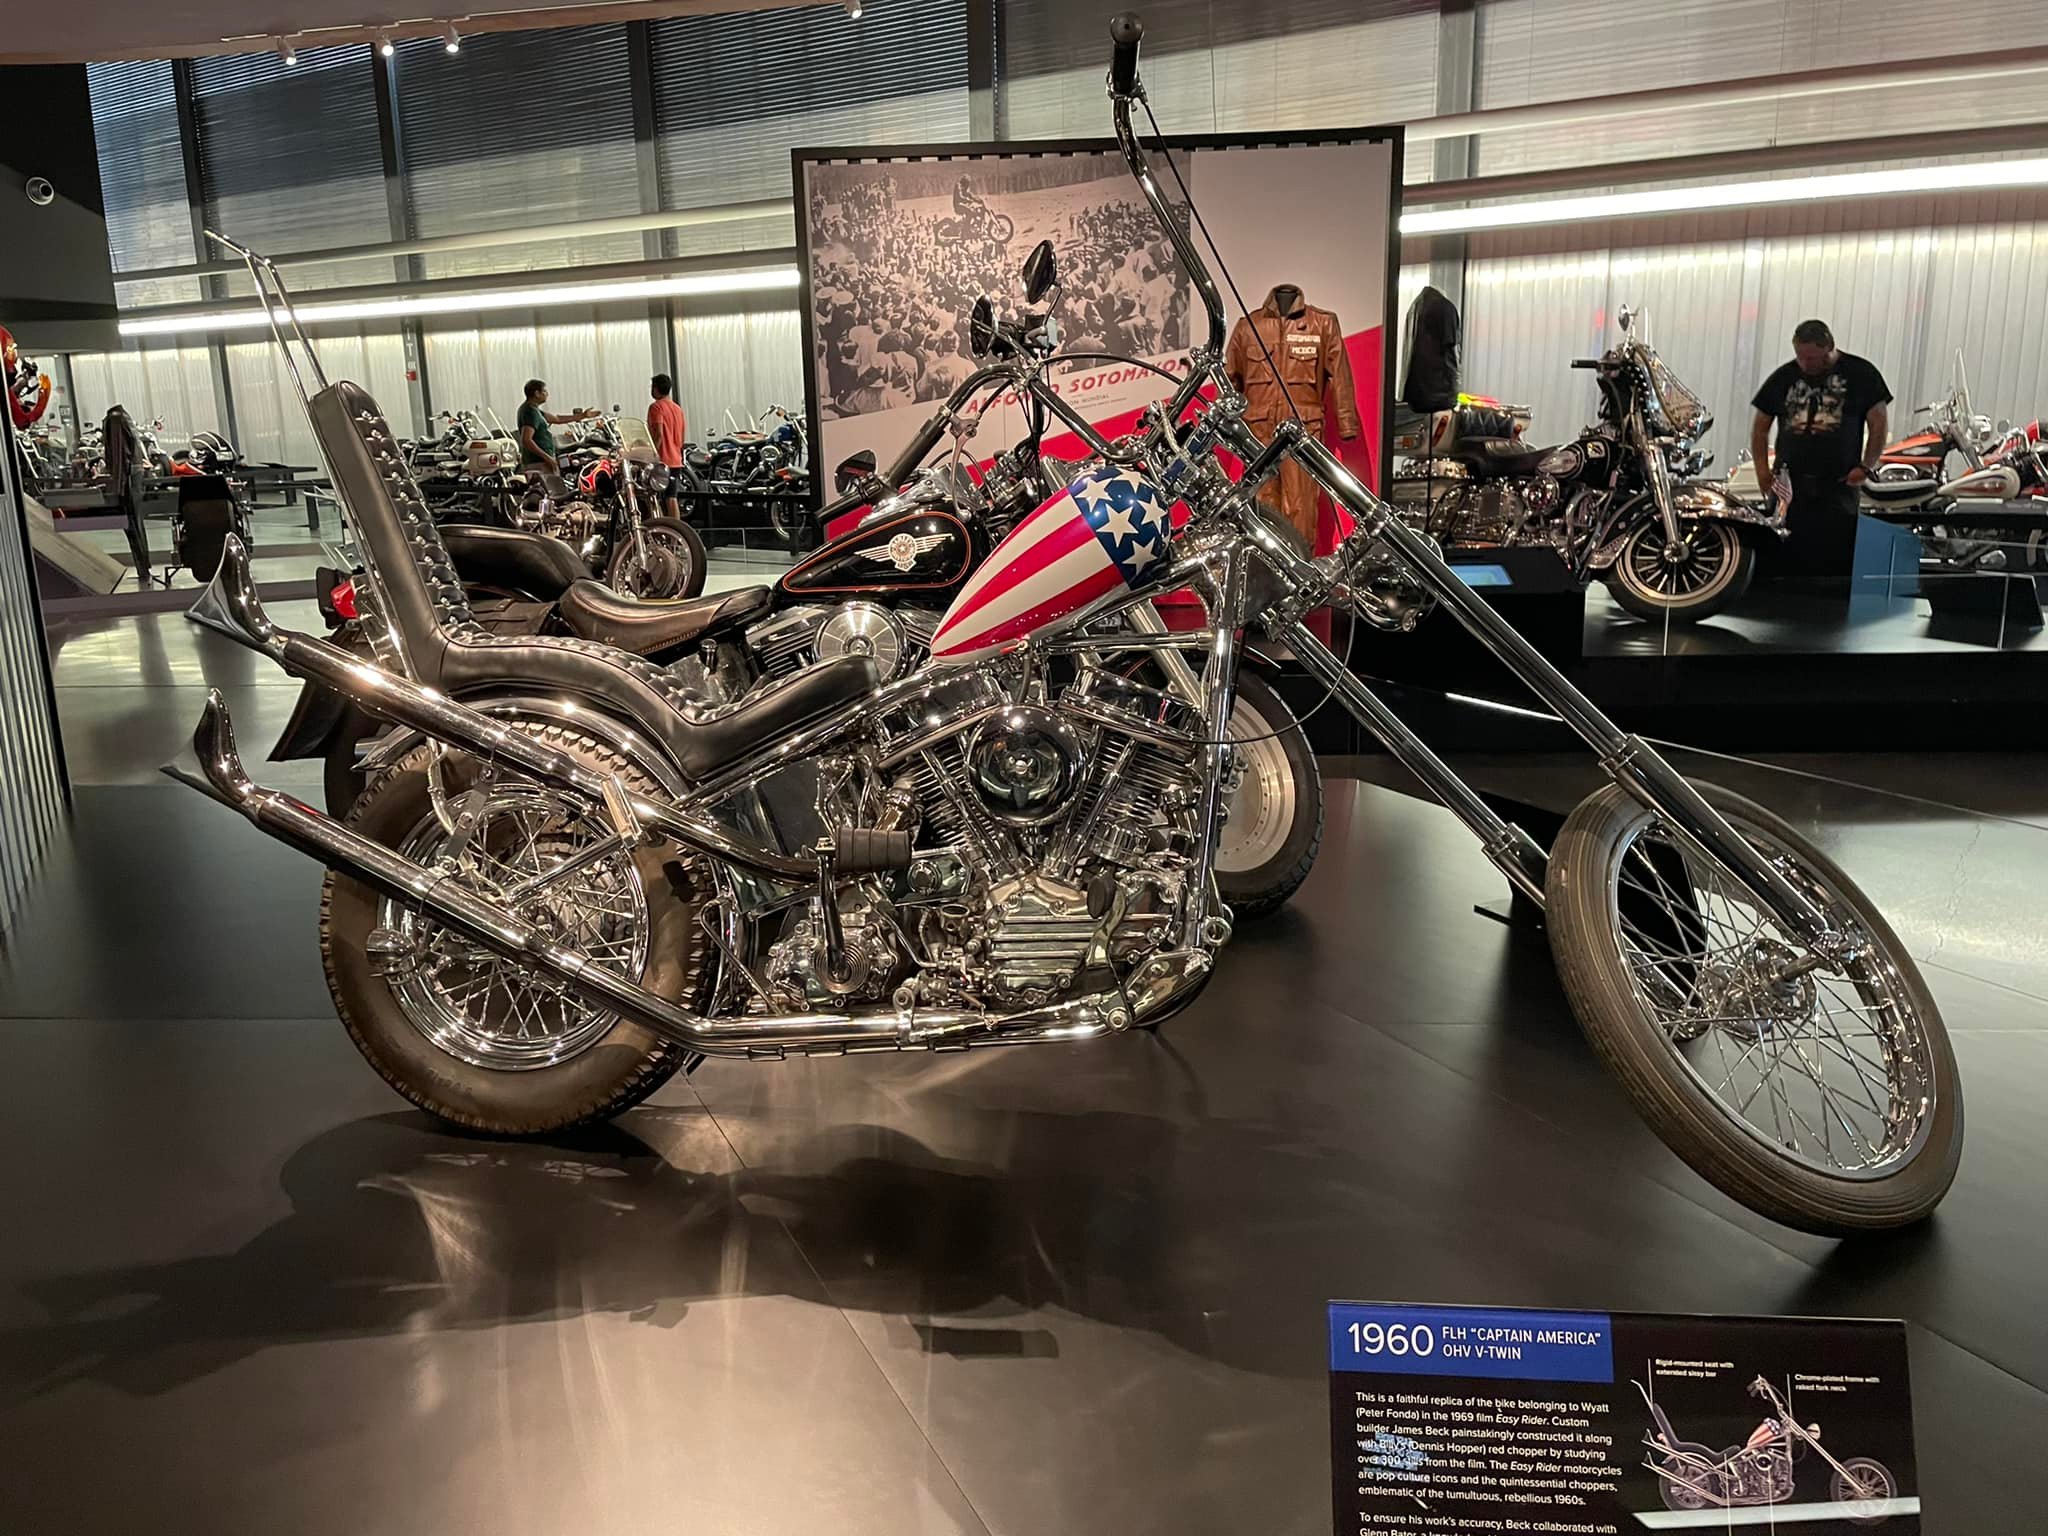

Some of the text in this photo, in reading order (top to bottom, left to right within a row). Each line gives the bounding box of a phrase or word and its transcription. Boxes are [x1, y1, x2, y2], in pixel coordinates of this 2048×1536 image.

[1348, 1322, 1434, 1357] 1960
[1442, 1326, 1601, 1346] FLH "CAPTAIN AMERICA"
[1443, 1345, 1521, 1360] OHV V-TWIN
[1356, 1392, 1376, 1402] This
[1378, 1394, 1386, 1402] is
[1396, 1394, 1428, 1404] faithful
[1430, 1396, 1463, 1407] replica
[1465, 1397, 1475, 1406] of
[1477, 1398, 1493, 1407] the
[1495, 1398, 1516, 1408] bike
[1518, 1400, 1567, 1413] belonging
[1569, 1403, 1579, 1411] to
[1581, 1402, 1609, 1414] Wyatt
[1356, 1408, 1589, 1427] (Peter Fonda) in the 1969 film Easy Rider. Custom
[1357, 1423, 1612, 1446] builder James Beck painstakingly constructed it along
[1357, 1439, 1377, 1448] with
[1447, 1443, 1486, 1455] Hopper)
[1488, 1445, 1505, 1454] red
[1507, 1446, 1547, 1458] chopper
[1550, 1448, 1562, 1459] by
[1564, 1448, 1606, 1461] studying
[1425, 1458, 1448, 1468] from
[1450, 1458, 1466, 1468] the
[1468, 1459, 1487, 1469] film.
[1490, 1460, 1508, 1470] The
[1510, 1461, 1534, 1473] Easy
[1536, 1462, 1562, 1472] Rider
[1564, 1464, 1622, 1477] motorcycles
[1358, 1472, 1618, 1492] are pop culture icons and the quintessential choppers,
[1358, 1486, 1586, 1505] emblematic of the tumultuous, rebellious 1960s.
[1359, 1513, 1617, 1534] To ensure his work's accuracy, Beck collaborated with
